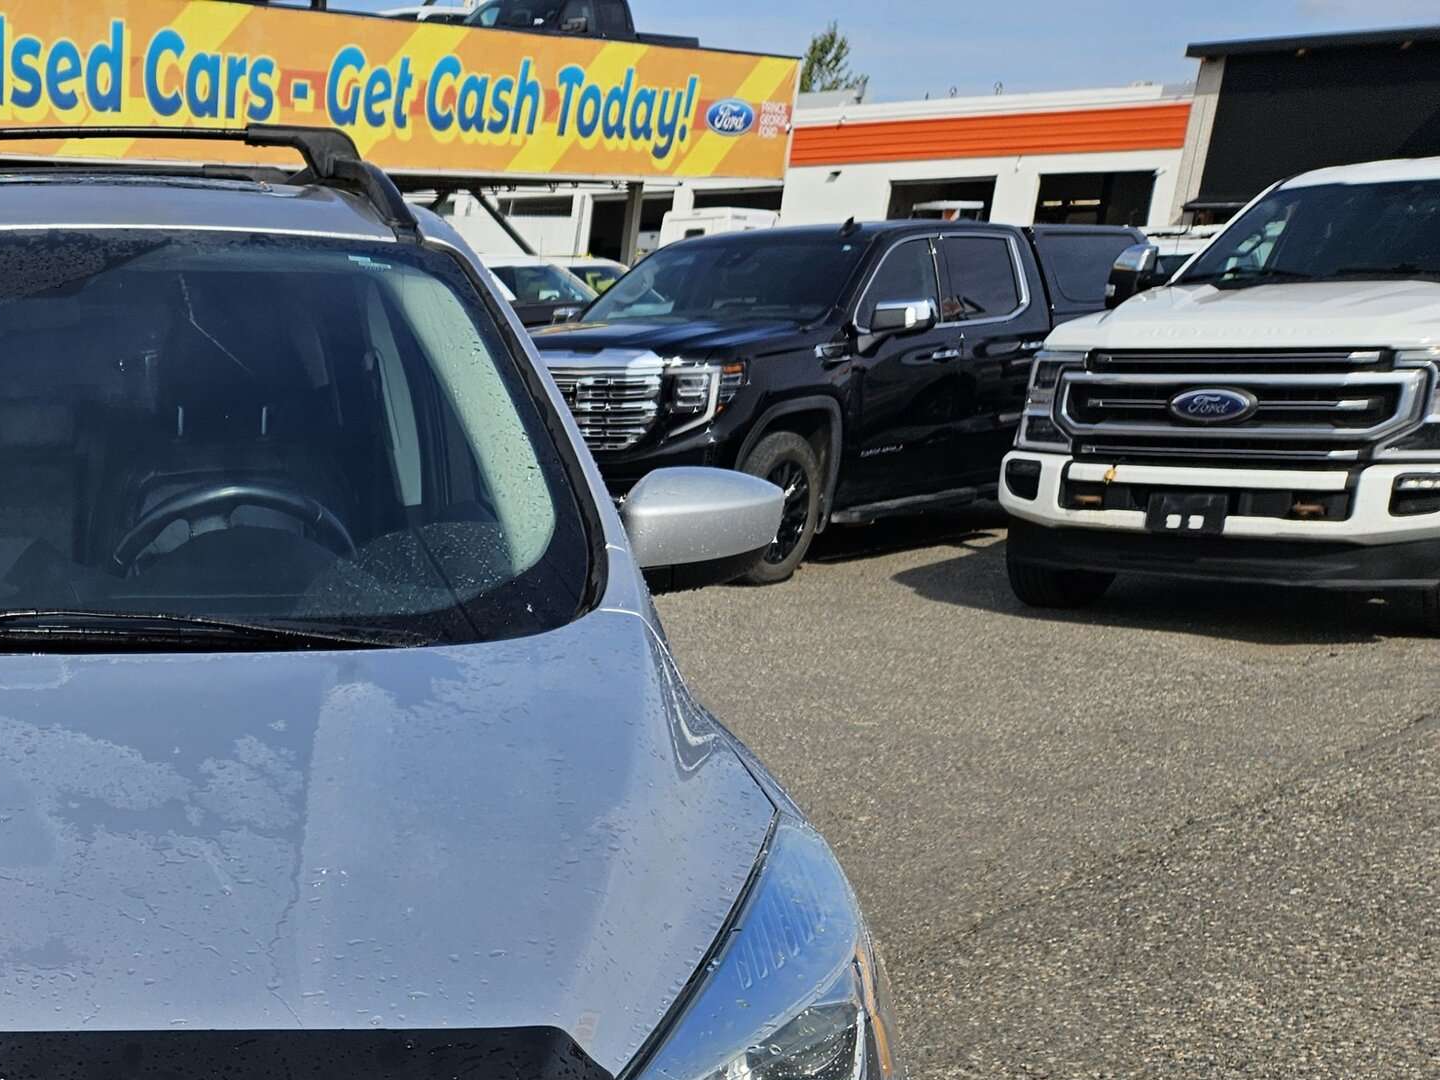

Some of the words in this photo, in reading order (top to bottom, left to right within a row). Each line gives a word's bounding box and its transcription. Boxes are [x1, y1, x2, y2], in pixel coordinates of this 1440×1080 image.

[143, 28, 276, 122] Cars
[326, 46, 414, 129] Get
[426, 54, 541, 136] Cash
[557, 64, 700, 161] Today!
[713, 103, 747, 130] Ford
[1186, 395, 1230, 414] Ford
